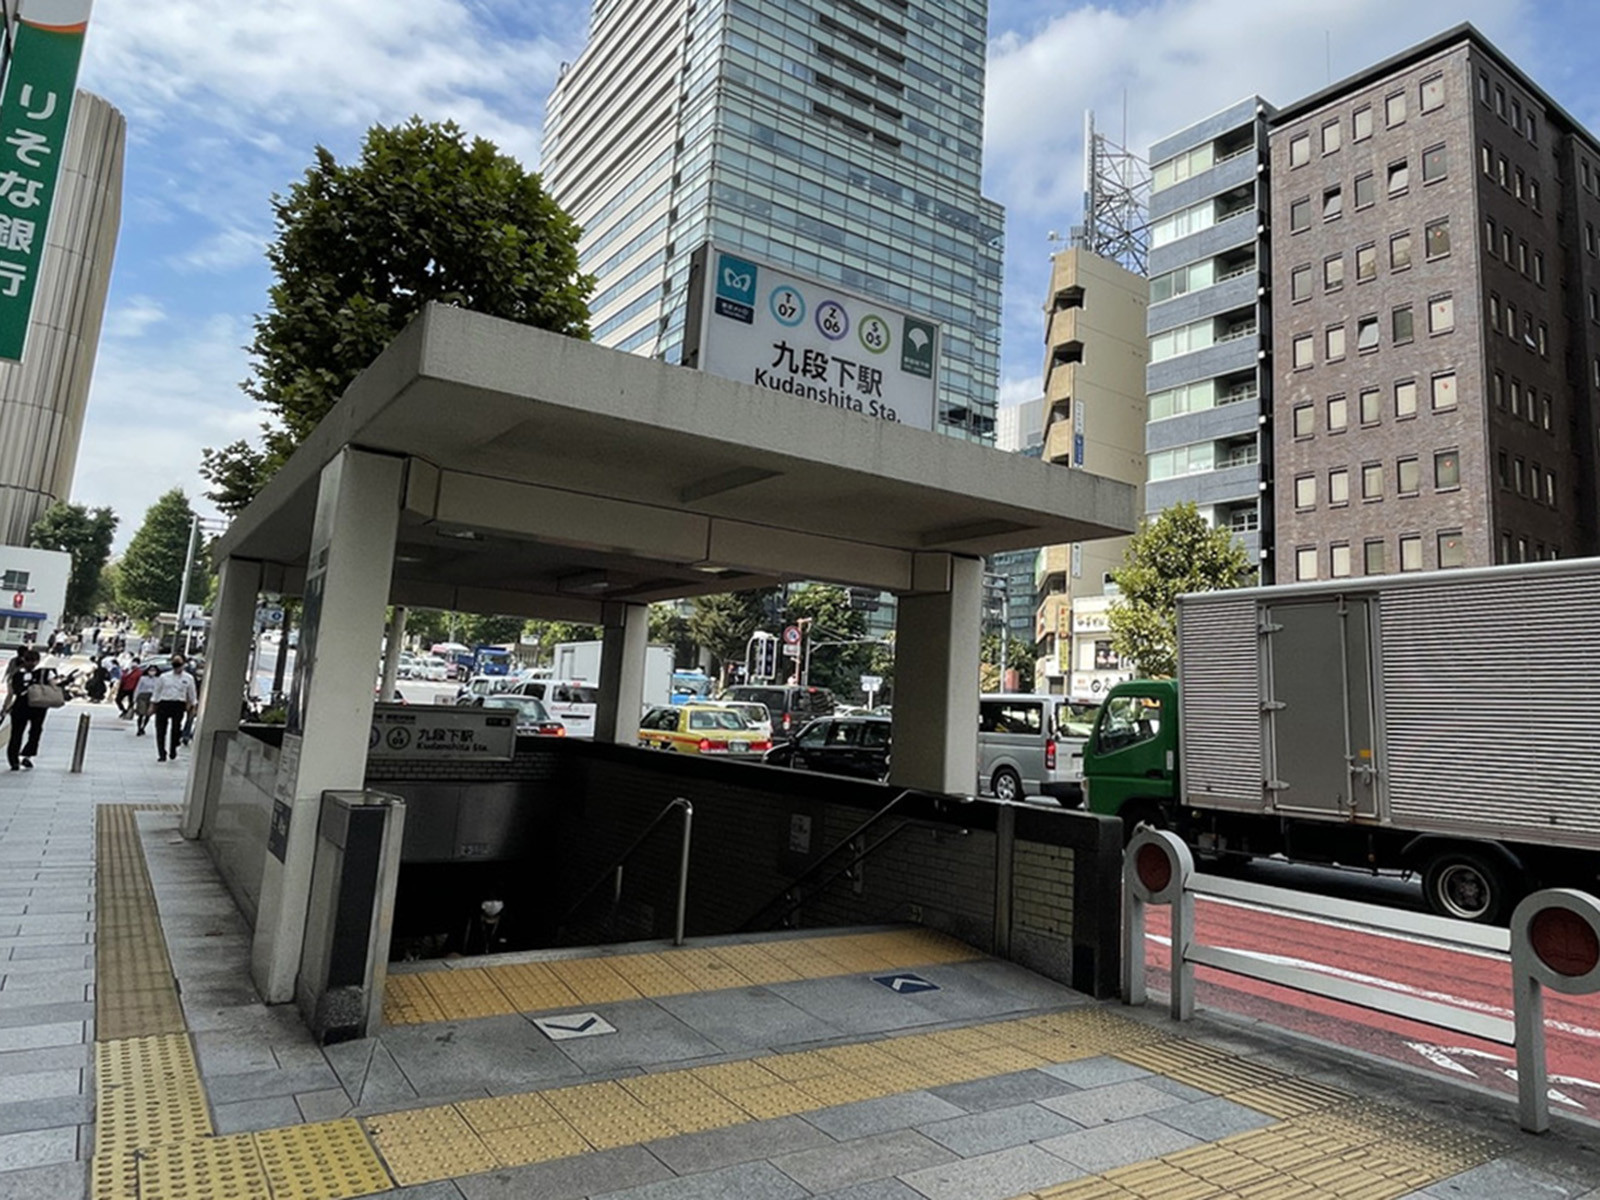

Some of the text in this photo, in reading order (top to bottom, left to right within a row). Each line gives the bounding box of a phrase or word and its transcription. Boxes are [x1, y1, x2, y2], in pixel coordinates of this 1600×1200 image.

[784, 292, 792, 304] T
[777, 304, 796, 319] 07
[828, 307, 837, 319] Z
[823, 318, 841, 333] 06
[871, 321, 879, 332] S
[865, 331, 882, 347] 05
[772, 340, 883, 398] 九段下駅
[754, 367, 902, 423] Kudanshita Sta.
[417, 728, 475, 743] 九段下駅
[416, 742, 470, 752] Kudanshita
